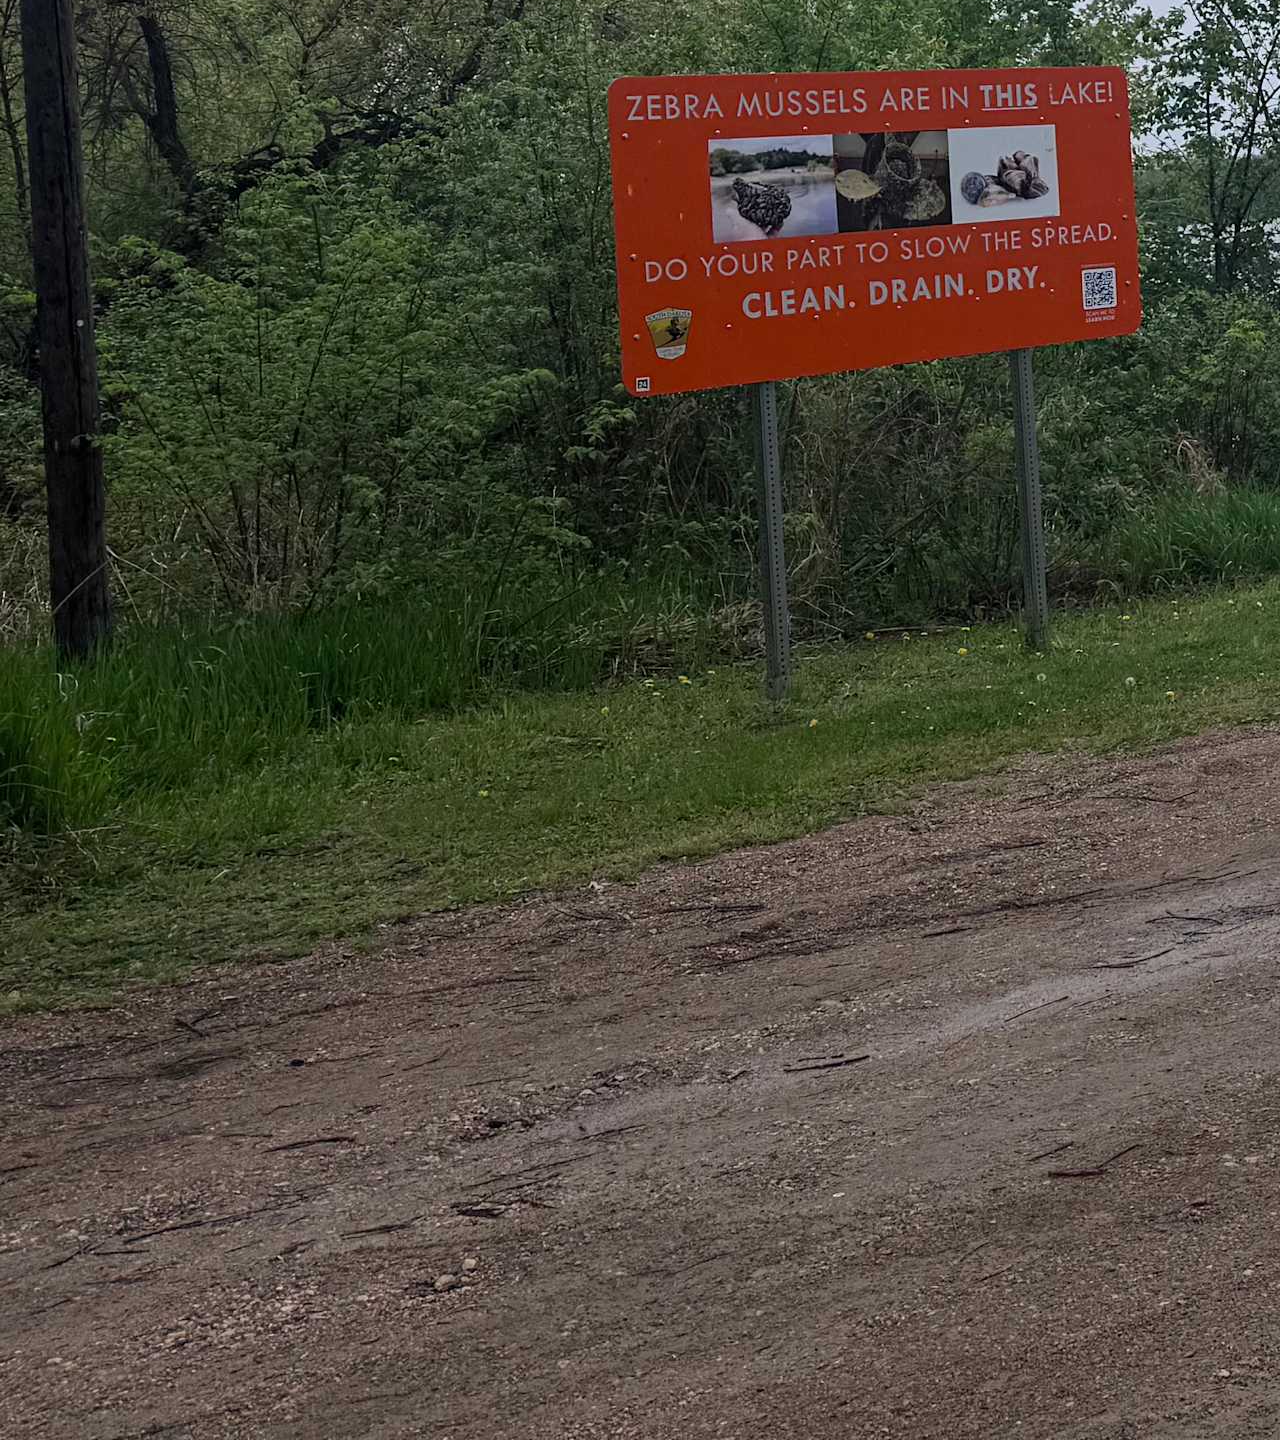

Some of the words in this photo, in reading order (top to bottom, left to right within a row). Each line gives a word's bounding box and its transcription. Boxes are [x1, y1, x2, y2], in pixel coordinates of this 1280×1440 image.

[626, 93, 724, 121] ZEBRA
[736, 88, 868, 117] MUSSELS
[879, 87, 930, 111] ARE
[941, 86, 968, 109] IN
[979, 83, 1038, 110] THIS
[1049, 81, 1113, 105] LAKE!
[645, 258, 688, 282] DO
[700, 251, 774, 277] YOUR
[787, 245, 845, 270] PART
[856, 241, 889, 263] TO
[900, 234, 971, 260] SLOW
[981, 230, 1022, 253] THE
[1031, 222, 1117, 248] SPREAD.
[742, 284, 856, 319] CLEAN.
[869, 273, 974, 305] DRAIN.
[987, 266, 1045, 294] DRY.
[638, 380, 648, 388] 24
